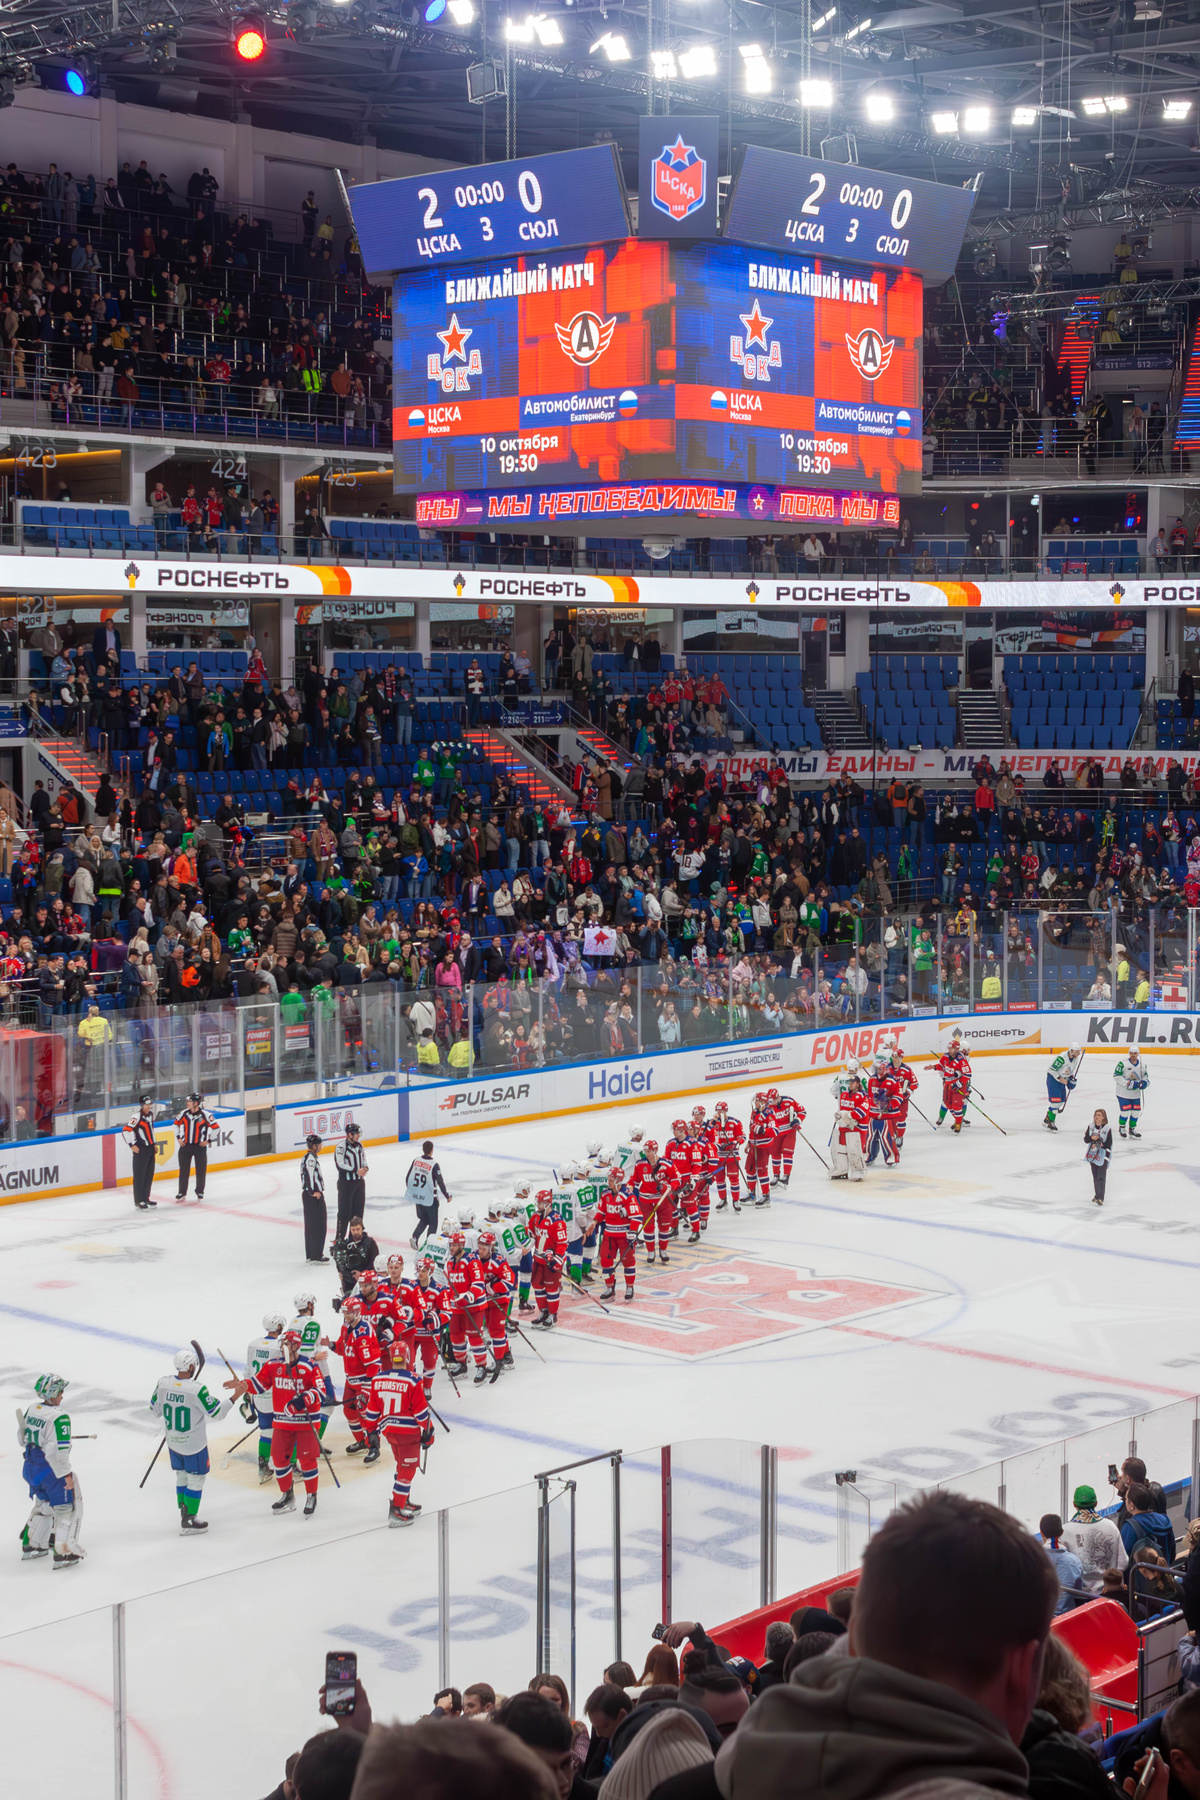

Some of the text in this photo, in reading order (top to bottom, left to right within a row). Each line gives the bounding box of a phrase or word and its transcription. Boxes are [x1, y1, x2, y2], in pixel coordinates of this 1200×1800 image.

[455, 180, 505, 207] 00:00
[518, 171, 543, 213] 0
[661, 170, 695, 199] ЦСКА
[801, 173, 826, 215] 2
[839, 182, 883, 209] 00:00
[418, 188, 443, 229] 2
[891, 189, 913, 230] 0
[480, 217, 494, 241] 3
[519, 219, 559, 241] СЮЛ
[785, 219, 825, 243] ЦСКА
[845, 218, 859, 242] 3
[416, 233, 462, 258] ЦСКА
[876, 235, 910, 256] СЮЛ
[446, 262, 594, 304] БЛИЖАЙШИЙ МАТЧ
[749, 263, 878, 305] БЛИЖАЙШИЙ МАТЧ
[730, 335, 782, 381] ЦСКА
[427, 349, 482, 392] ЦСКА
[524, 395, 616, 415] Автомобилист
[730, 392, 762, 412] ЦСКА
[428, 406, 462, 425] ЦСКА
[570, 410, 616, 423] Екатеринбург
[730, 410, 752, 421] Москва
[819, 403, 894, 425] Автомобилист
[428, 424, 450, 434] Москва
[857, 424, 894, 435] Екатеринбург
[480, 434, 558, 453] 10 октября
[780, 433, 848, 455] 10 октября
[211, 458, 248, 480] 424
[499, 453, 538, 474] 19:30
[797, 454, 831, 475] 19:30
[323, 466, 357, 488] 425
[488, 494, 531, 518] МЫ
[539, 486, 737, 515] НЕПОБЕДИМЫ!
[779, 493, 834, 517] ПОКА
[841, 498, 877, 521] МЫ
[883, 501, 899, 523] Е
[157, 568, 289, 590] РОСНЕФТЬ
[480, 578, 587, 598] РОСНЕФТЬ
[776, 585, 911, 602] РОСНЕФТЬ
[1143, 586, 1200, 601] РОС
[18, 595, 57, 617] 329
[533, 716, 545, 724] 211
[778, 757, 818, 773] МЫ
[826, 756, 916, 773] ЕДИНЫ
[964, 1028, 1025, 1039] РОСНЕФТЬ
[588, 1064, 653, 1100] Haier
[453, 1083, 530, 1109] PULSAR
[302, 1111, 355, 1137] ЦСКА
[619, 1154, 629, 1169] 7
[413, 1173, 427, 1188] 59
[305, 1331, 317, 1341] 33
[363, 1348, 370, 1359] 5
[166, 1392, 185, 1403] LEIVO
[162, 1403, 191, 1433] 90
[61, 1425, 70, 1436] 31
